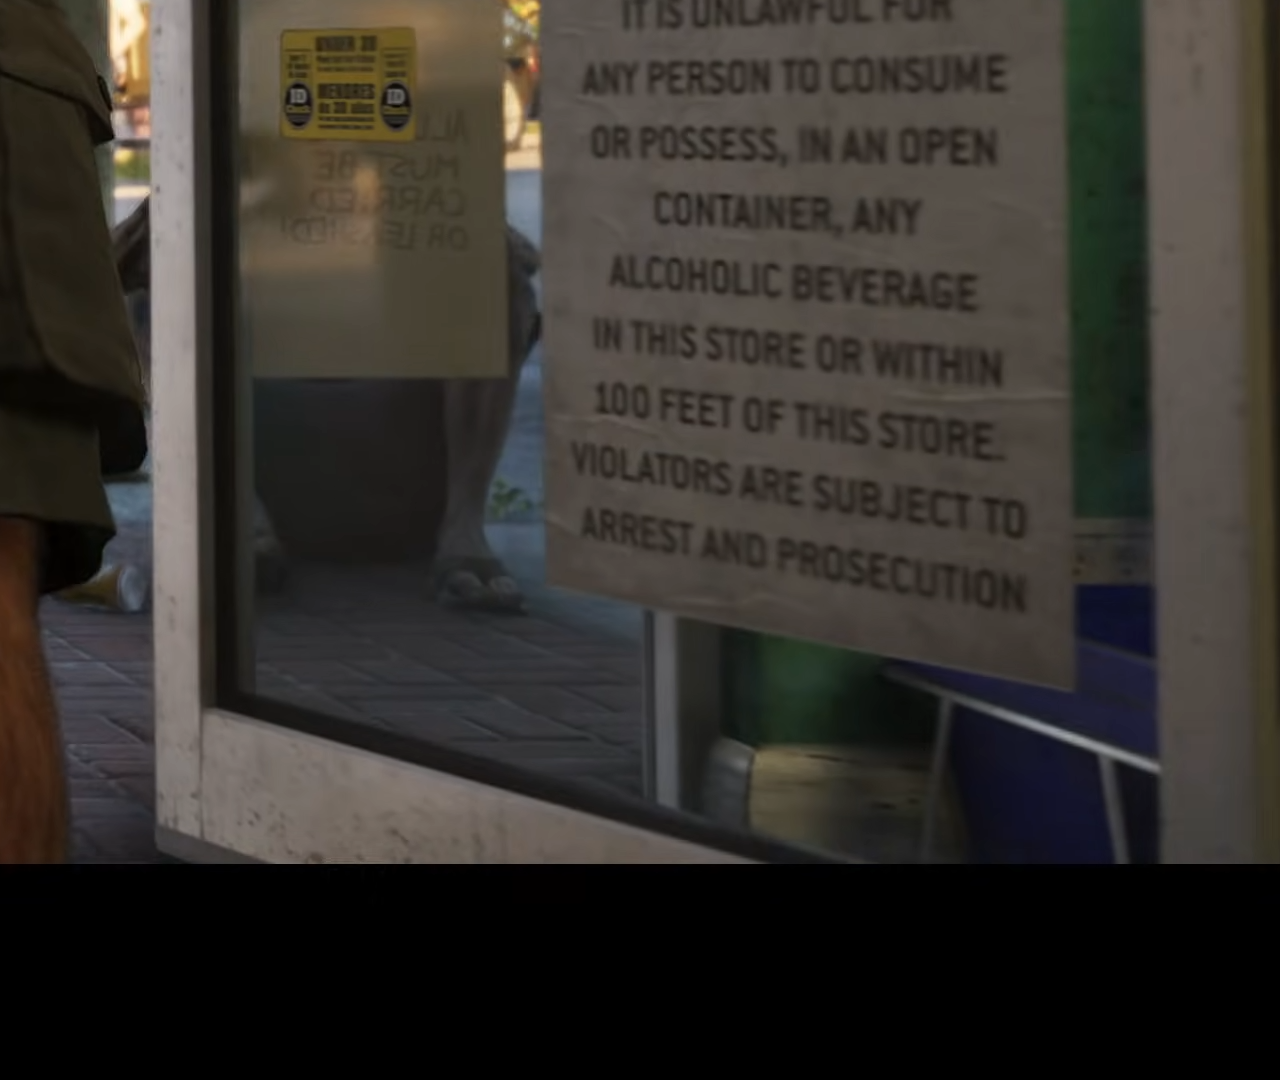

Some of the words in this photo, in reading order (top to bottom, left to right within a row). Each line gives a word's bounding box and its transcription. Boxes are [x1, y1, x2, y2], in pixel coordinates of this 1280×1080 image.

[582, 60, 641, 98] ANY
[647, 57, 771, 95] PERSON
[781, 57, 821, 94] TO
[829, 53, 1010, 94] CONSUME
[590, 124, 632, 161] OR
[641, 125, 788, 167] POSSESS,
[798, 127, 833, 164] IN
[842, 127, 888, 165] AN
[898, 127, 999, 167] OPEN
[653, 191, 845, 238] CONTAINER,
[850, 197, 924, 236] ANY
[608, 253, 784, 299] ALCOHOLIC
[791, 263, 982, 314] BEVERAGE
[592, 316, 623, 352] IN
[630, 320, 698, 360] THIS
[704, 325, 807, 371] STORE
[815, 335, 864, 376] OR
[870, 339, 1005, 388] WITHIN
[593, 381, 652, 420] 100
[658, 387, 736, 429] FEET
[741, 396, 785, 435] OF
[793, 401, 872, 447] THIS
[876, 410, 1007, 463] STORE.
[570, 439, 735, 497] VIOLATORS
[739, 466, 806, 508] ARE
[811, 474, 974, 529] SUBJECT
[981, 496, 1029, 541] TO
[580, 507, 696, 556] ARREST
[700, 525, 768, 570] AND
[775, 536, 1029, 613] PROSECUTION
